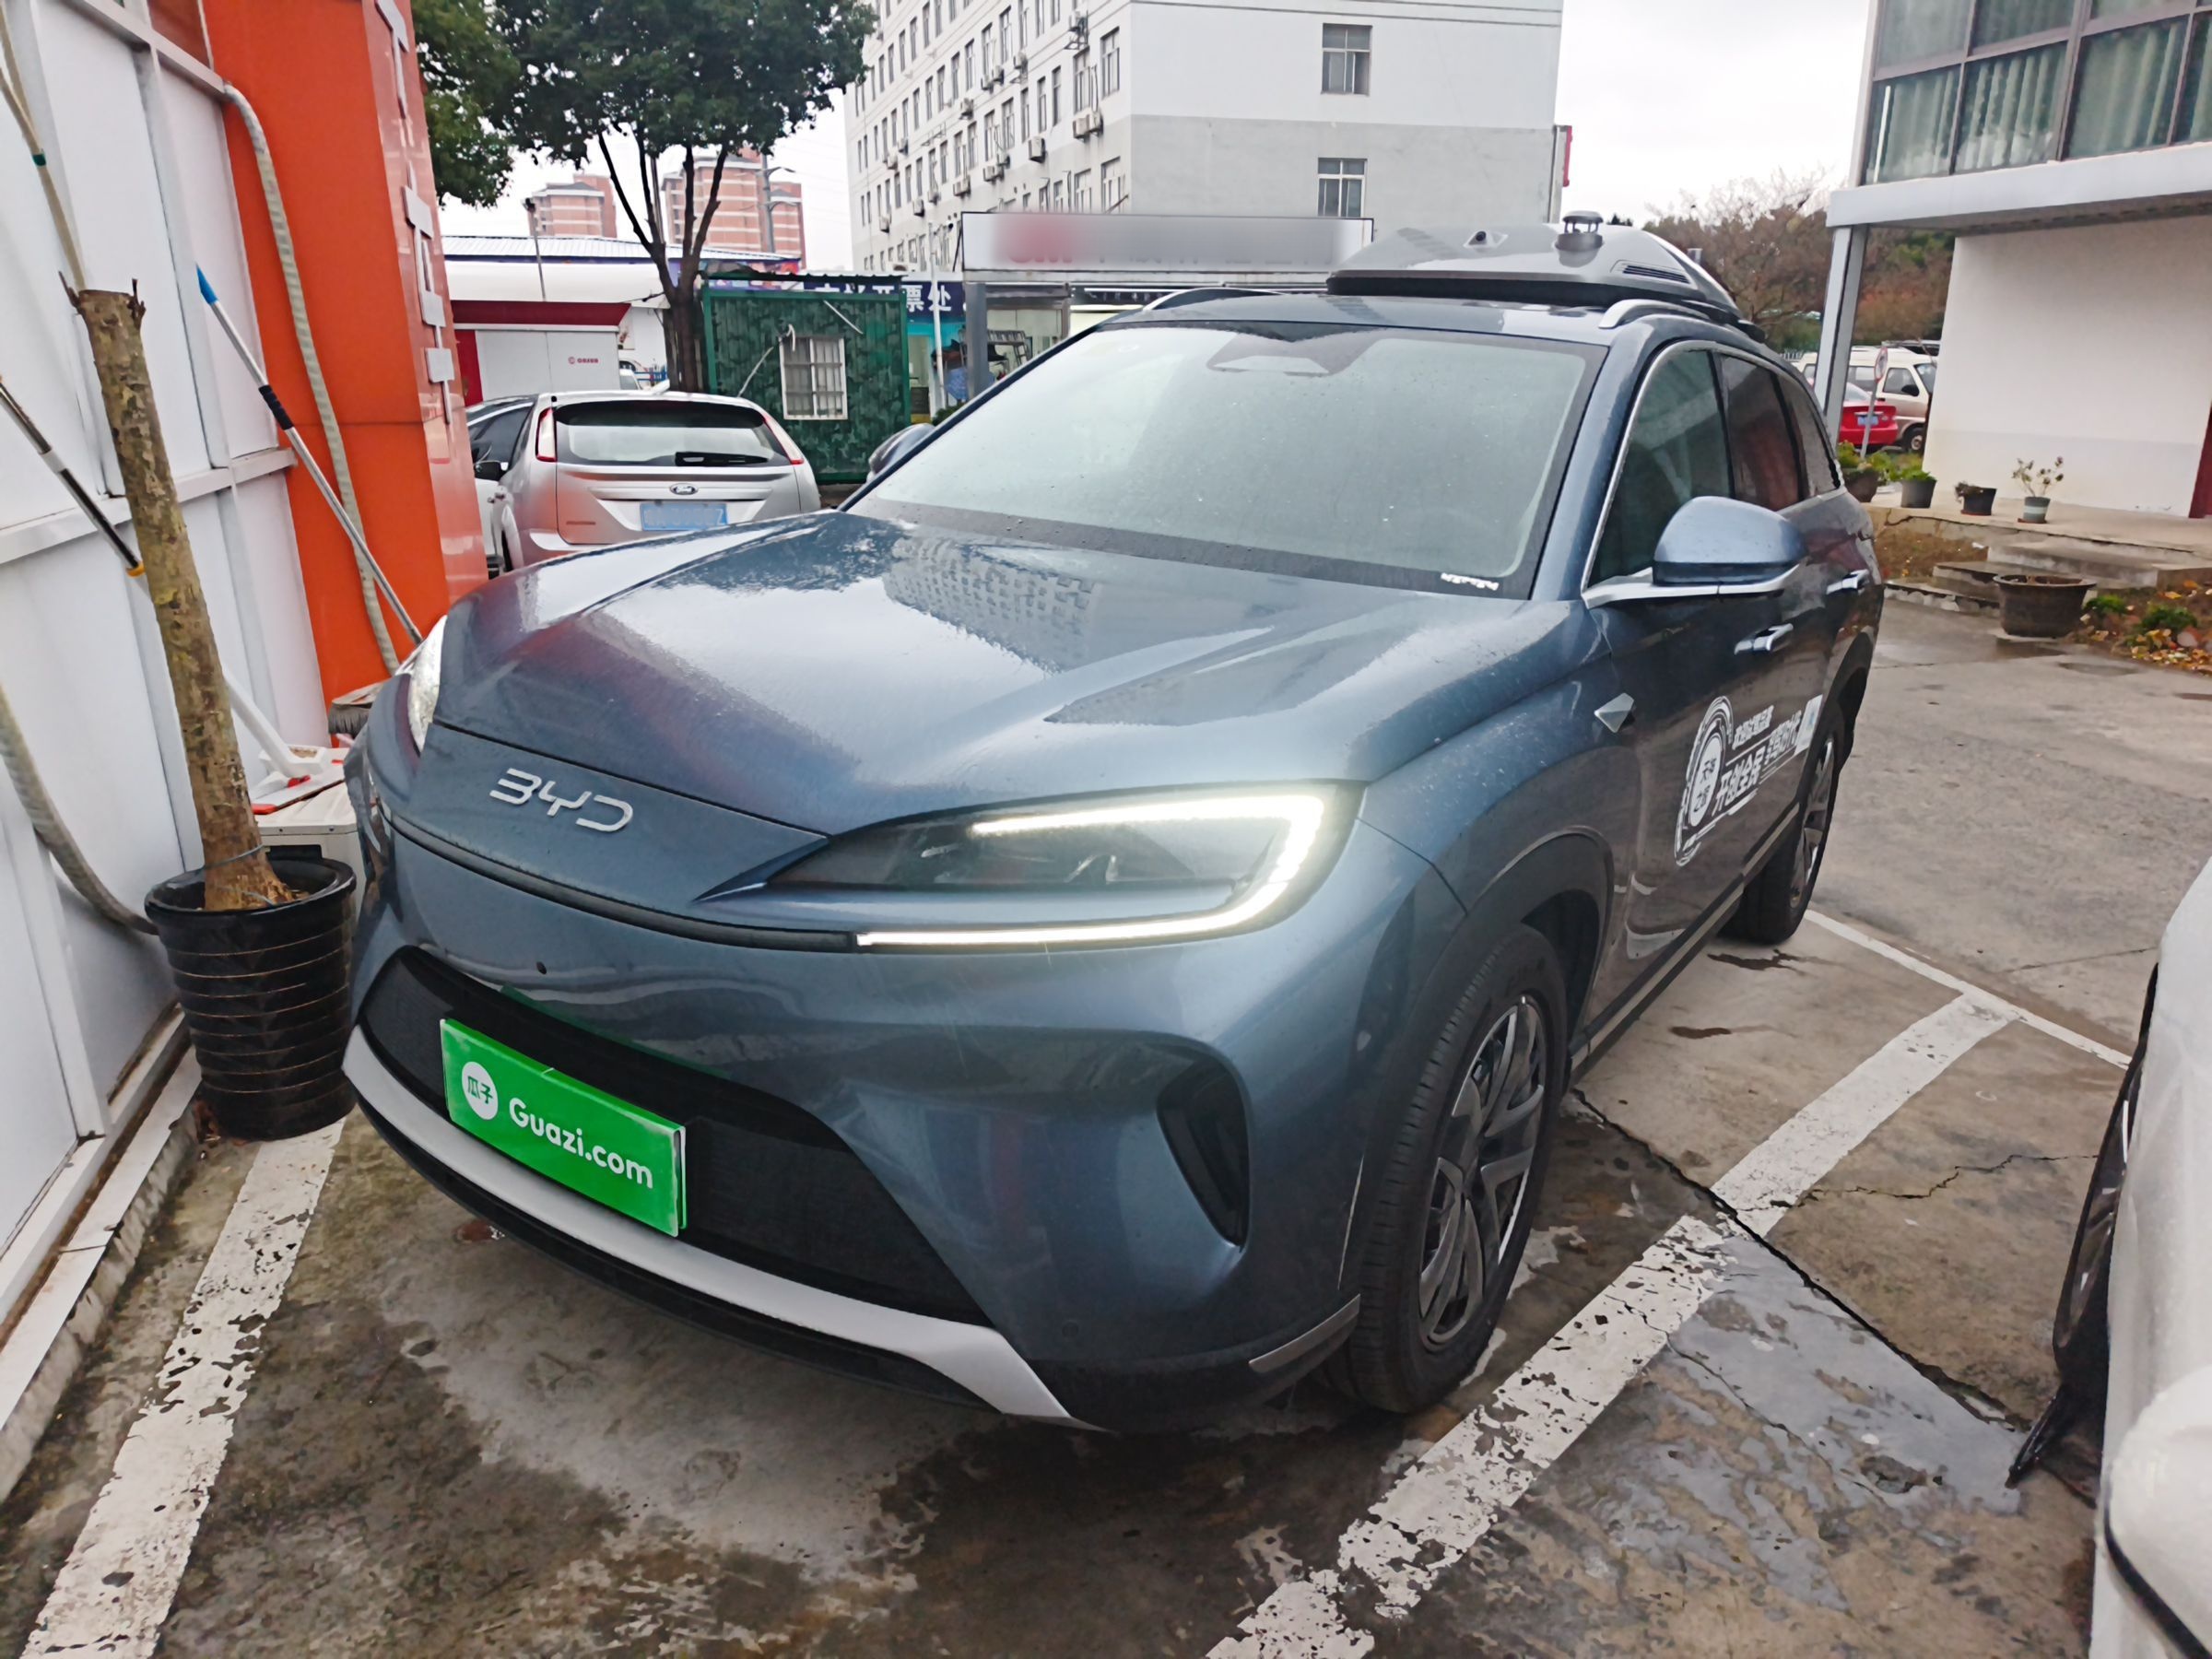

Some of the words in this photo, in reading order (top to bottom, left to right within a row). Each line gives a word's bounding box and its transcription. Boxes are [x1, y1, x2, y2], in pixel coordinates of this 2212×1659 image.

[489, 768, 633, 832] BYD
[466, 1075, 494, 1104] 瓜子
[509, 1097, 653, 1189] Guazi.com
